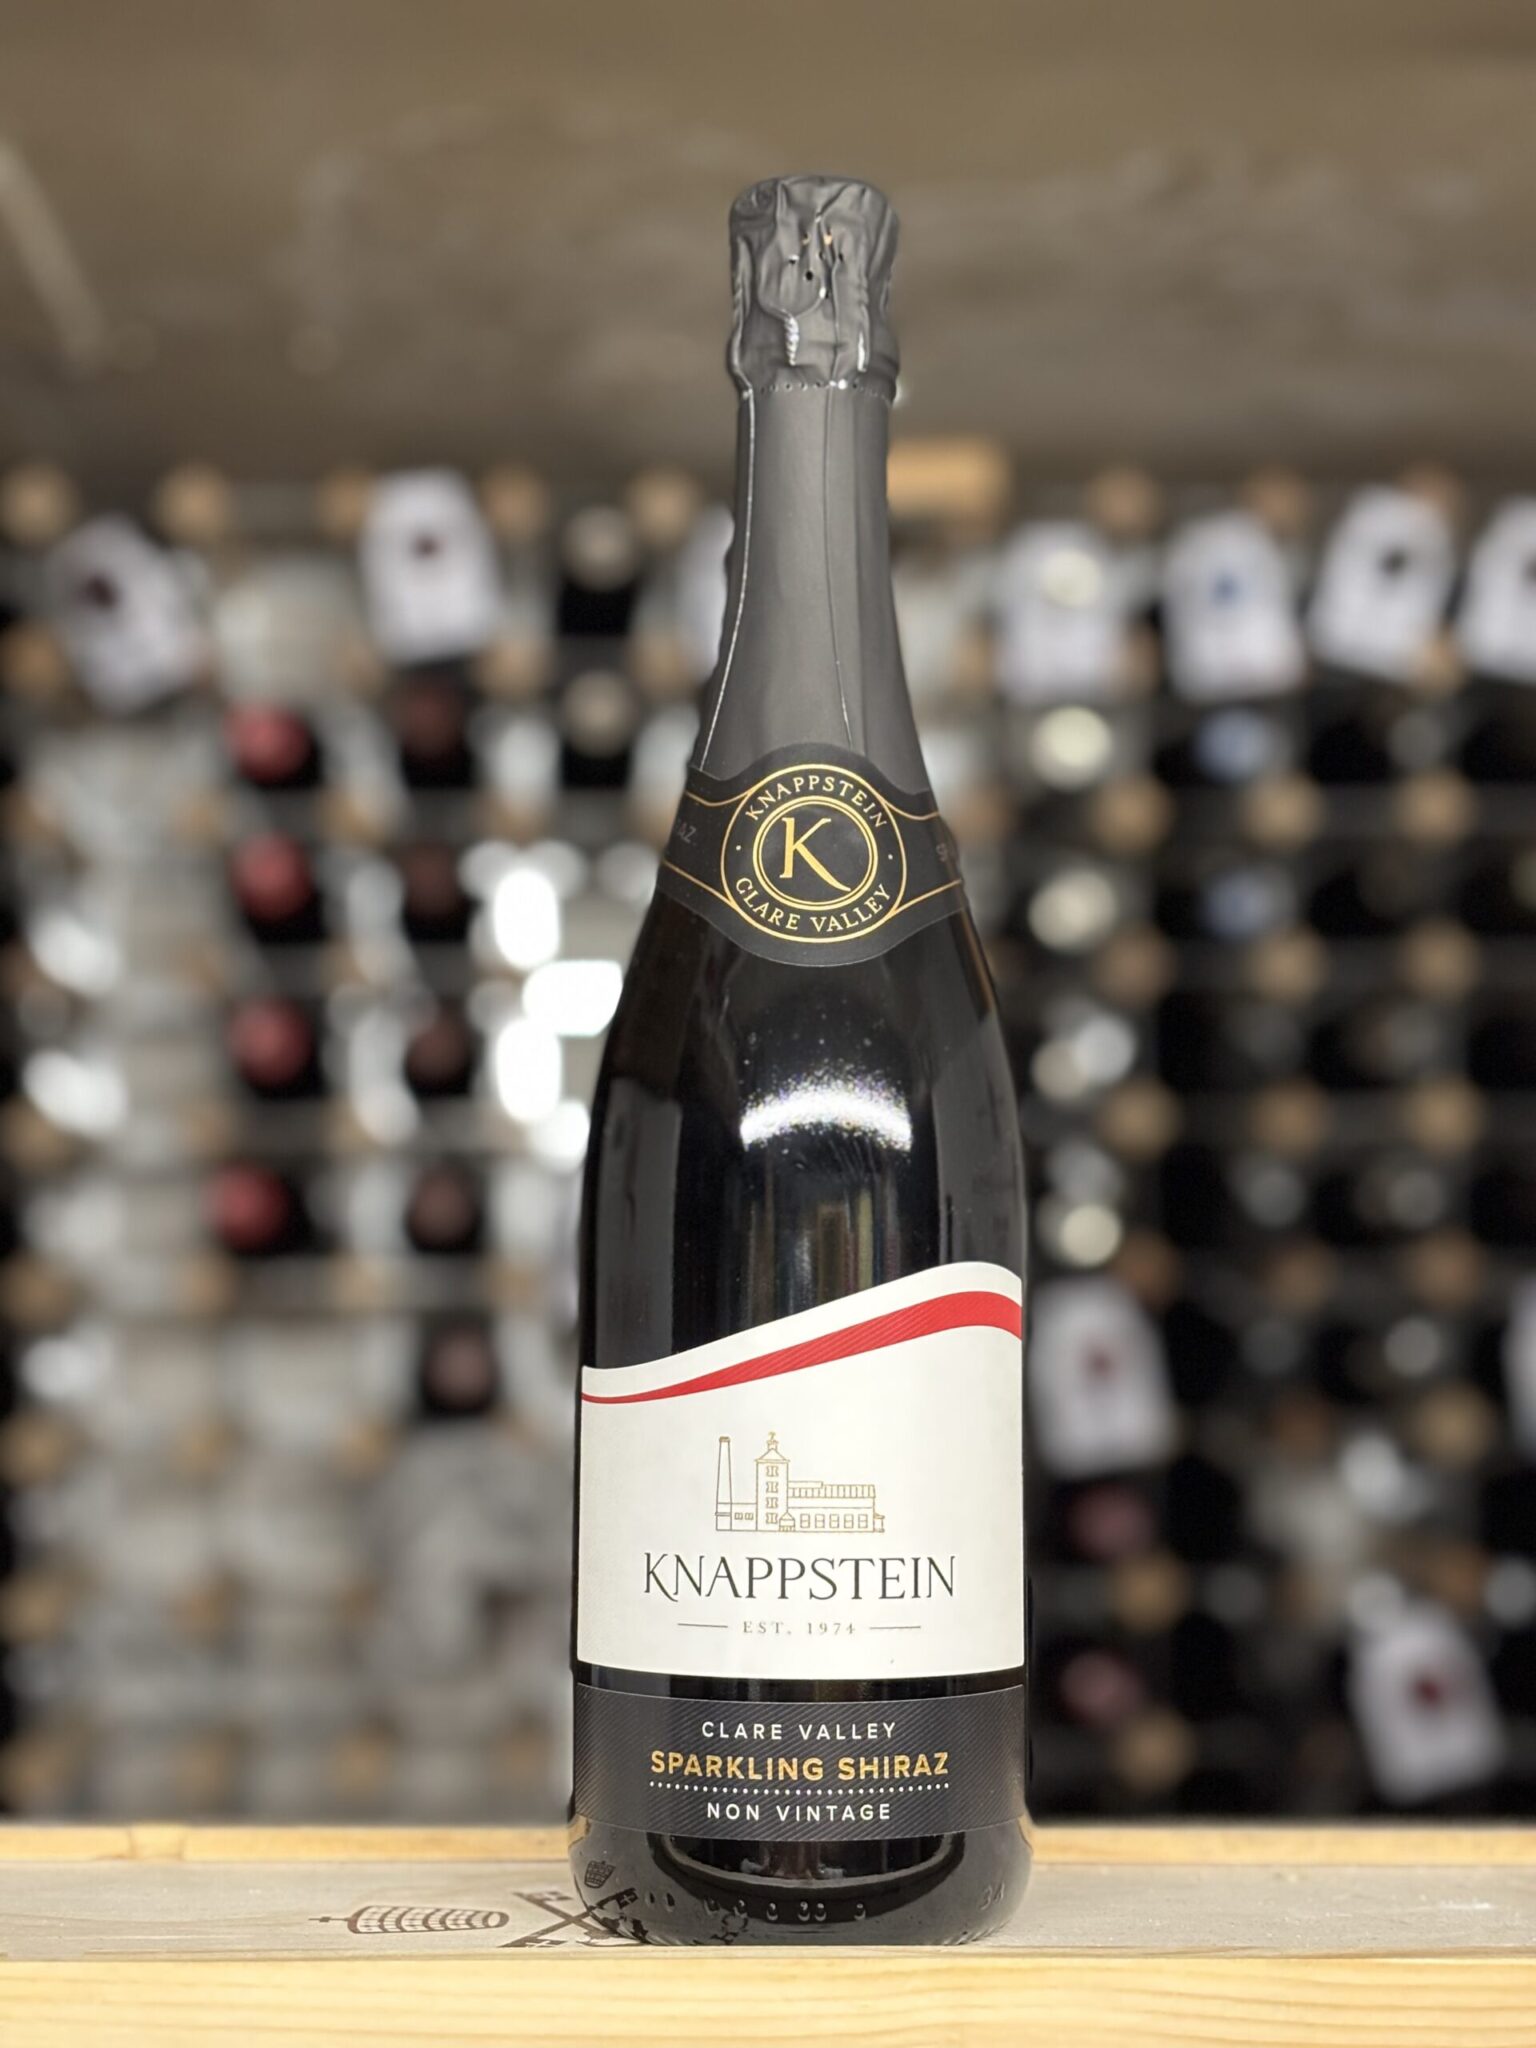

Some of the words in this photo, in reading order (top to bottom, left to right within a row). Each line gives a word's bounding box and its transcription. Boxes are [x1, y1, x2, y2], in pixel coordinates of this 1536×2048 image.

[745, 775, 888, 828] KNAPPSTEIN
[779, 816, 851, 892] K
[735, 877, 801, 931] CLARE
[810, 883, 891, 933] VALLEY
[644, 1552, 957, 1602] KNAPPSTEIN
[743, 1620, 793, 1635] EST.
[806, 1621, 856, 1635] 1974
[701, 1721, 783, 1741] CLARE
[799, 1721, 897, 1741] VALLEY
[650, 1750, 824, 1782] SPARKLING
[837, 1751, 949, 1781] SHIRAZ
[706, 1803, 760, 1821] NON
[776, 1803, 892, 1822] VINTAGE
